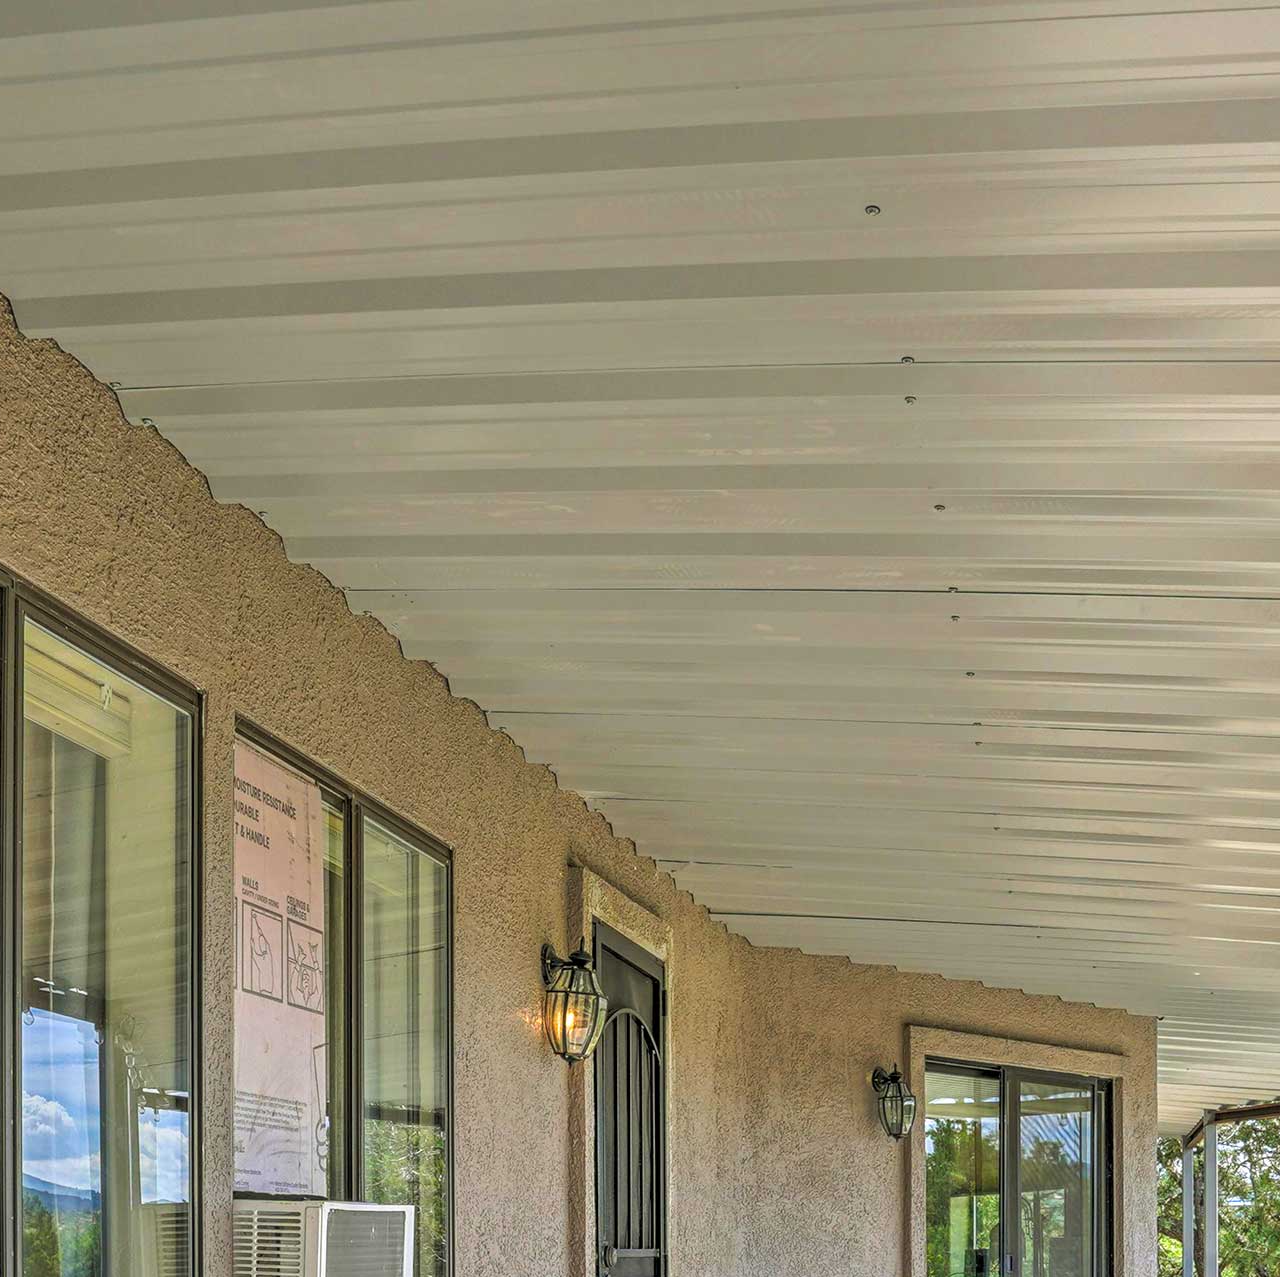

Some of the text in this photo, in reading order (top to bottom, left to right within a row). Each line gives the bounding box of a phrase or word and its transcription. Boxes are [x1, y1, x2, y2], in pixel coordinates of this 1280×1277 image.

[262, 791, 297, 820] RESISTANCE
[240, 825, 245, 838] &
[245, 826, 270, 850] HANDLE
[242, 875, 259, 891] WALLS
